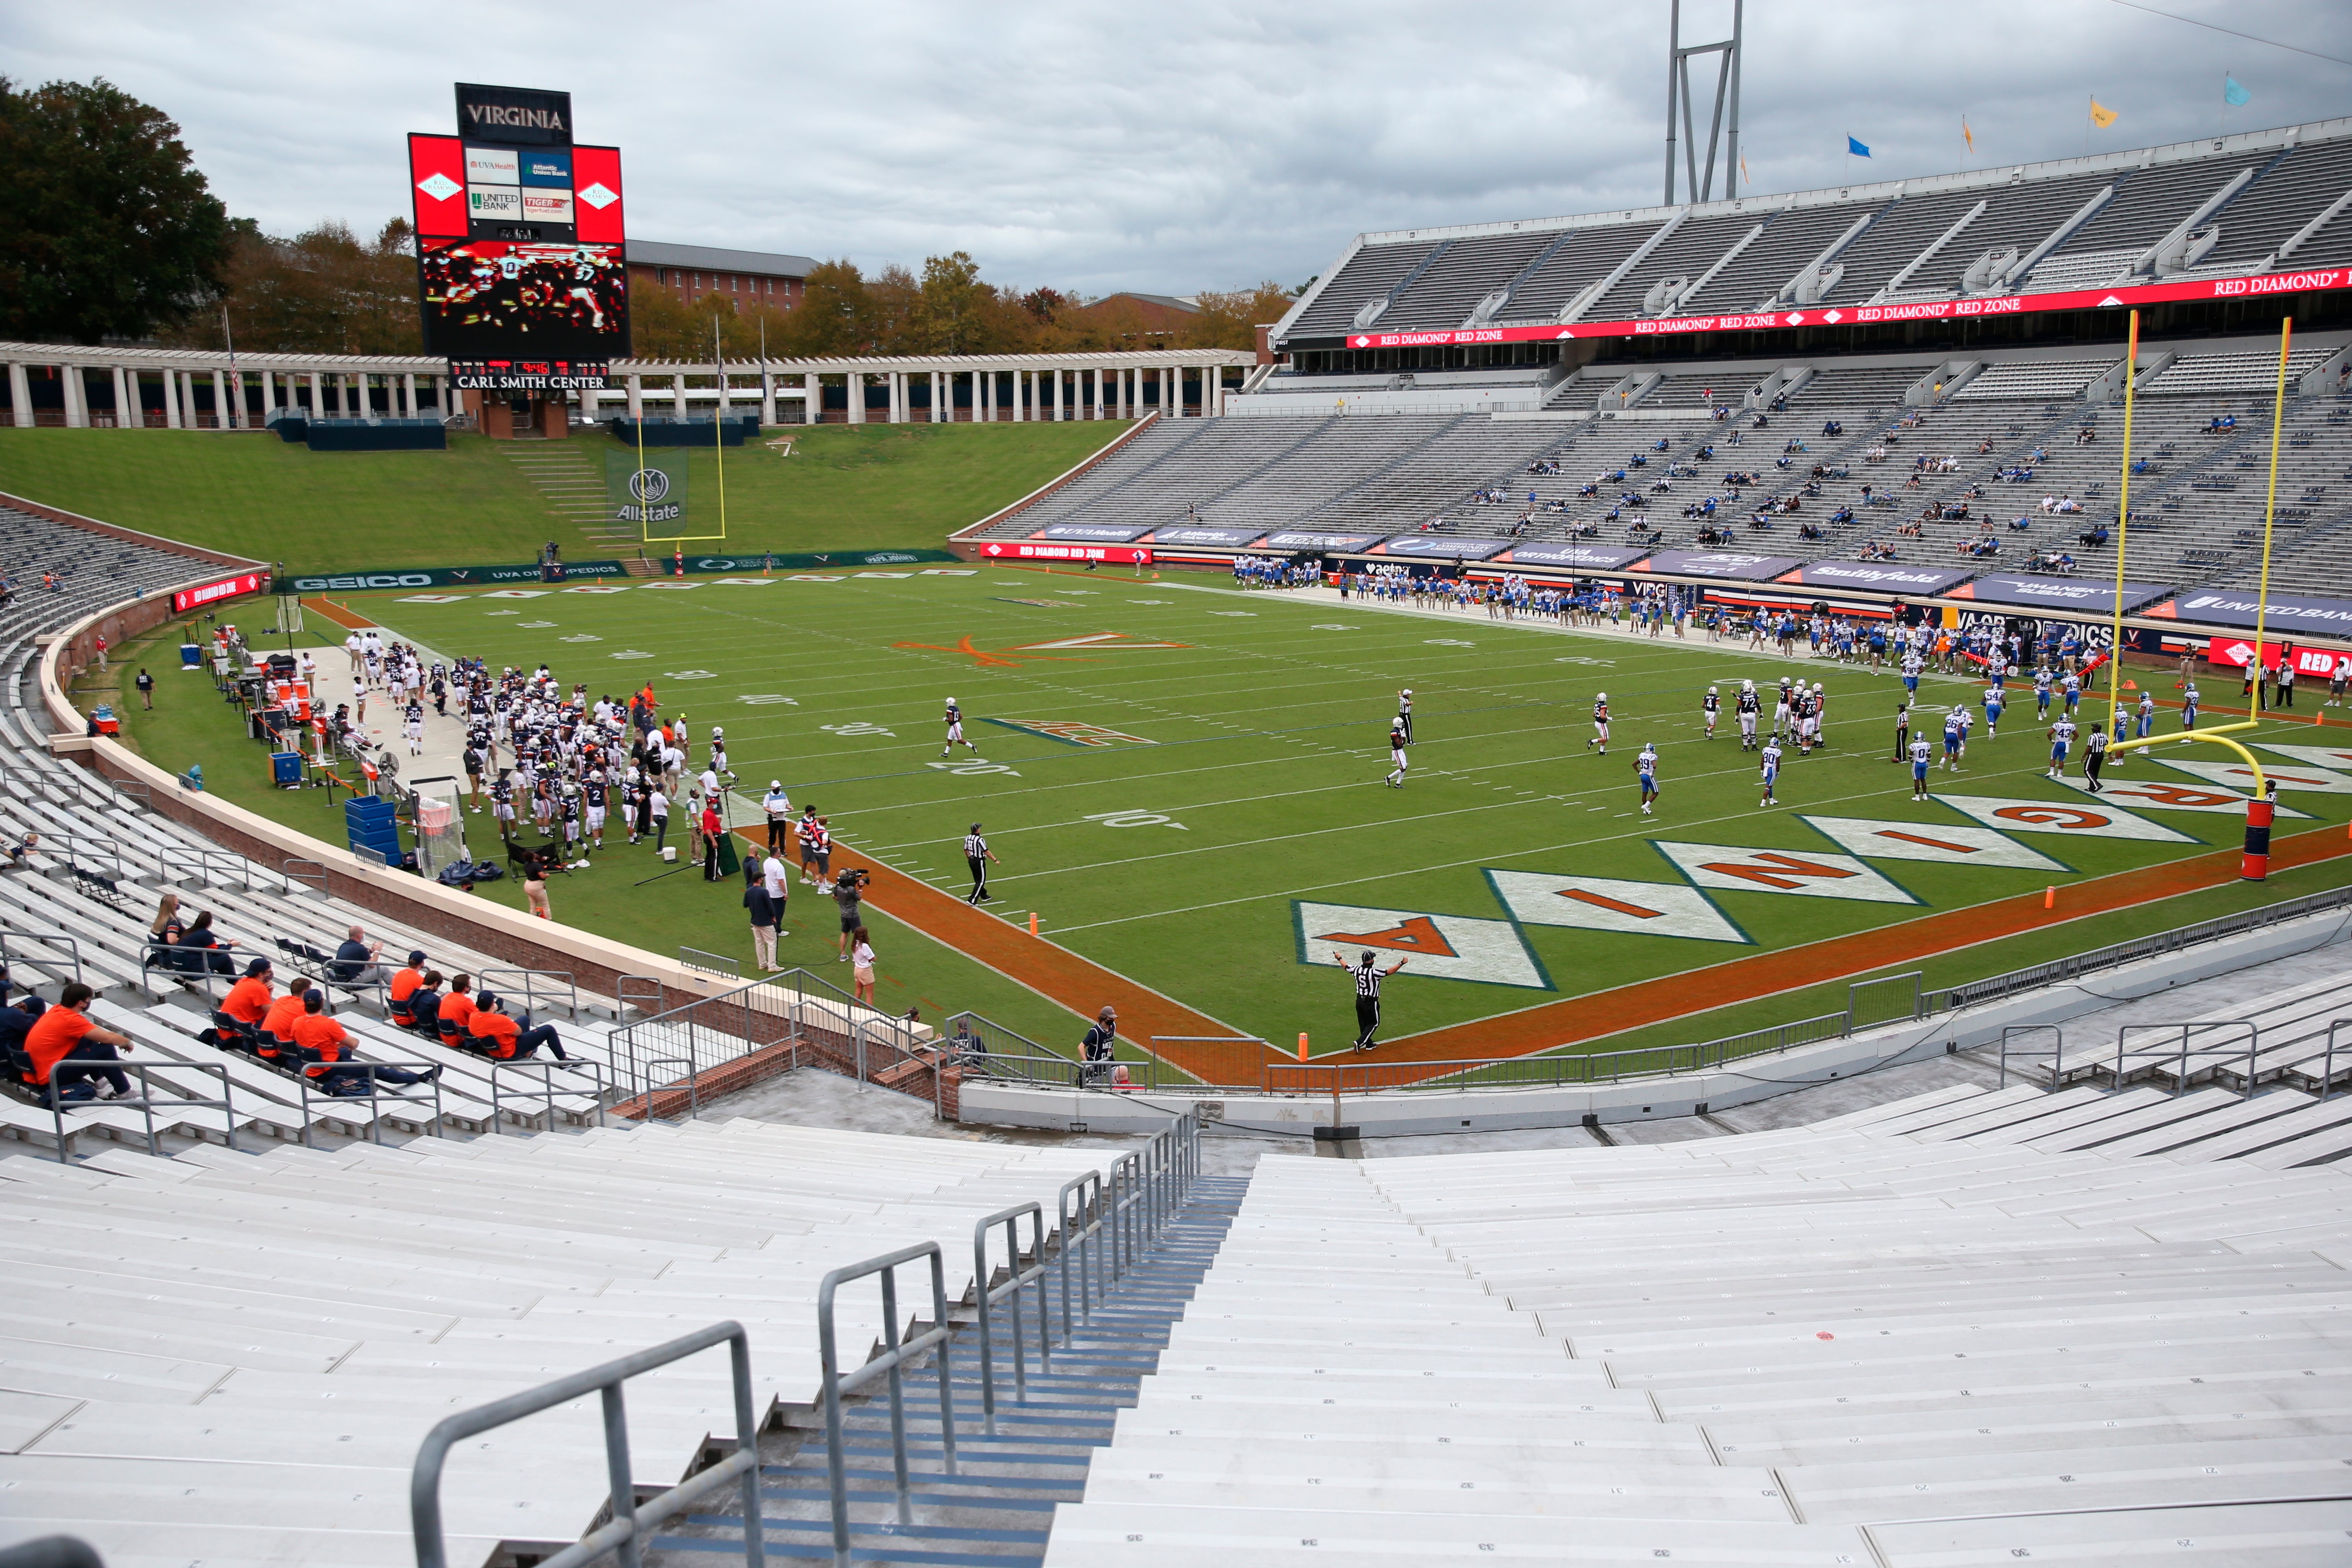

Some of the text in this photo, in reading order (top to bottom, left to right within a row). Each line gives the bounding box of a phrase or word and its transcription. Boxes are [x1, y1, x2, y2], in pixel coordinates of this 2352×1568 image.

[467, 103, 563, 130] VIRGINIA
[482, 193, 519, 202] UNITED
[526, 198, 554, 206] TIGER
[483, 201, 510, 211] BANK
[2214, 281, 2246, 295] RED
[1857, 309, 1881, 321] RED
[1955, 302, 1981, 314] RED
[1984, 299, 2020, 312] ZONE
[1635, 323, 1656, 333] RED
[1719, 318, 1742, 329] RED
[1744, 316, 1775, 327] ZONE
[1381, 335, 1400, 346] RED
[1455, 332, 1475, 342] RED
[1476, 330, 1503, 341] ZONE
[523, 363, 548, 374] 9:46
[458, 376, 605, 389] CARL SMITH CENTER
[616, 504, 679, 522] Allstate
[1019, 546, 1105, 559] RED DIAMOND RED ZONE
[1514, 551, 1620, 563] ORTHOPEDICS
[1810, 566, 1942, 583] Smithfield
[226, 581, 236, 594] ZONE
[294, 574, 432, 590] GEICO
[2015, 581, 2115, 595] UMANSKY
[2015, 588, 2089, 598] SUBARU
[2211, 601, 2352, 621] UNITED BAN
[1958, 612, 1976, 630] VA
[2283, 642, 2289, 652] 1
[2298, 652, 2333, 672] RED
[663, 669, 718, 680] 50
[2067, 680, 2078, 689] 45
[736, 694, 794, 705] 40
[1987, 691, 1999, 701] 54
[1706, 699, 1712, 709] 4
[1743, 699, 1756, 708] 72
[409, 710, 421, 720] 30
[1806, 704, 1817, 715] 69
[954, 711, 959, 721] 13
[820, 721, 889, 736] 30
[1946, 719, 1958, 729] 96
[2058, 729, 2069, 738] 43
[1918, 749, 1925, 759] 0
[925, 758, 1011, 776] 20
[593, 790, 600, 800] 2
[1081, 808, 1171, 828] 10
[1358, 975, 1367, 988] S
[1126, 1534, 1143, 1542] 35
[1301, 1539, 1318, 1547] 34
[2176, 1539, 2194, 1547] 29
[1478, 1543, 1494, 1551] 33
[1653, 1549, 1670, 1558] 32
[2011, 1548, 2030, 1558] 30
[1835, 1555, 1851, 1563] 31
